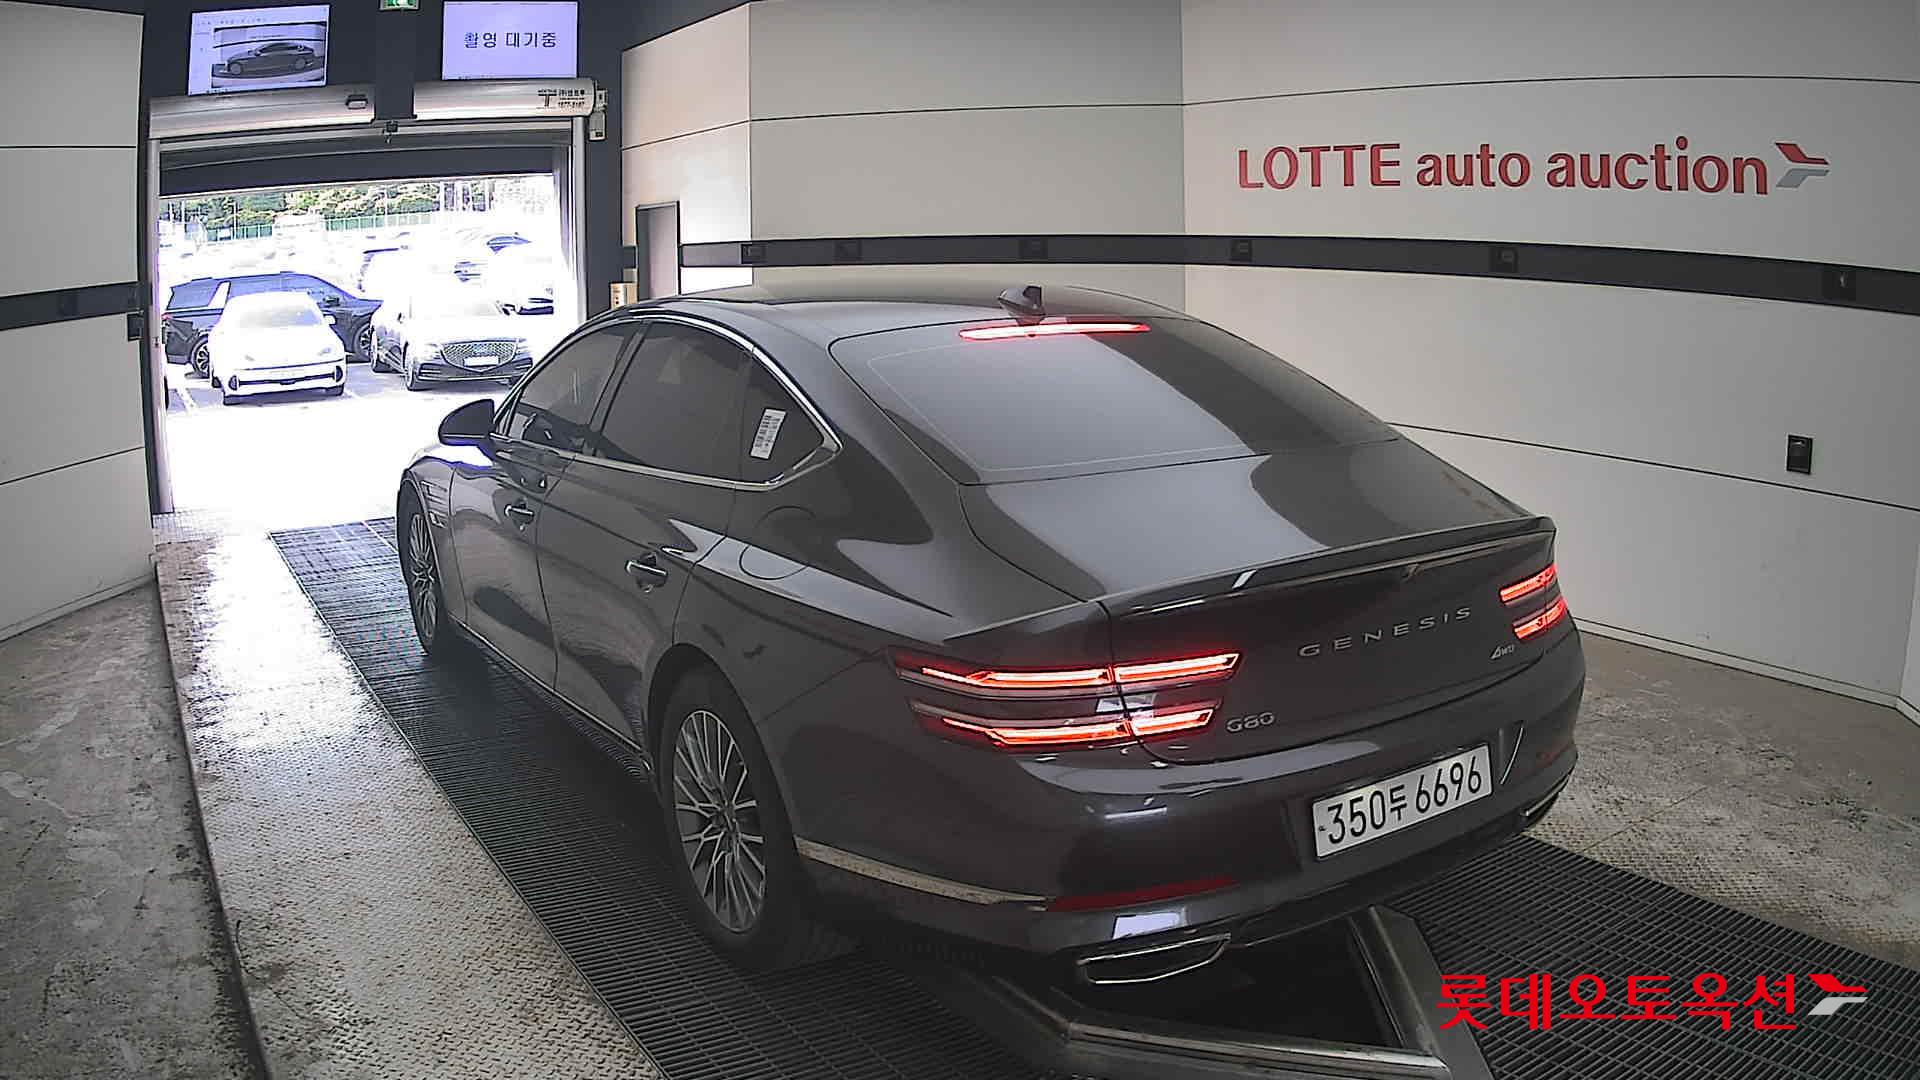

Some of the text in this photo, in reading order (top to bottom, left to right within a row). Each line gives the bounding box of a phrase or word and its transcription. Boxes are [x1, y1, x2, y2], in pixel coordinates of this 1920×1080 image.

[464, 32, 557, 49] 촬영 대기중
[1238, 135, 1768, 195] LOTTE auto auction
[1299, 607, 1471, 657] GENESIS
[1226, 712, 1275, 732] G80
[1327, 755, 1482, 844] 350두 6696
